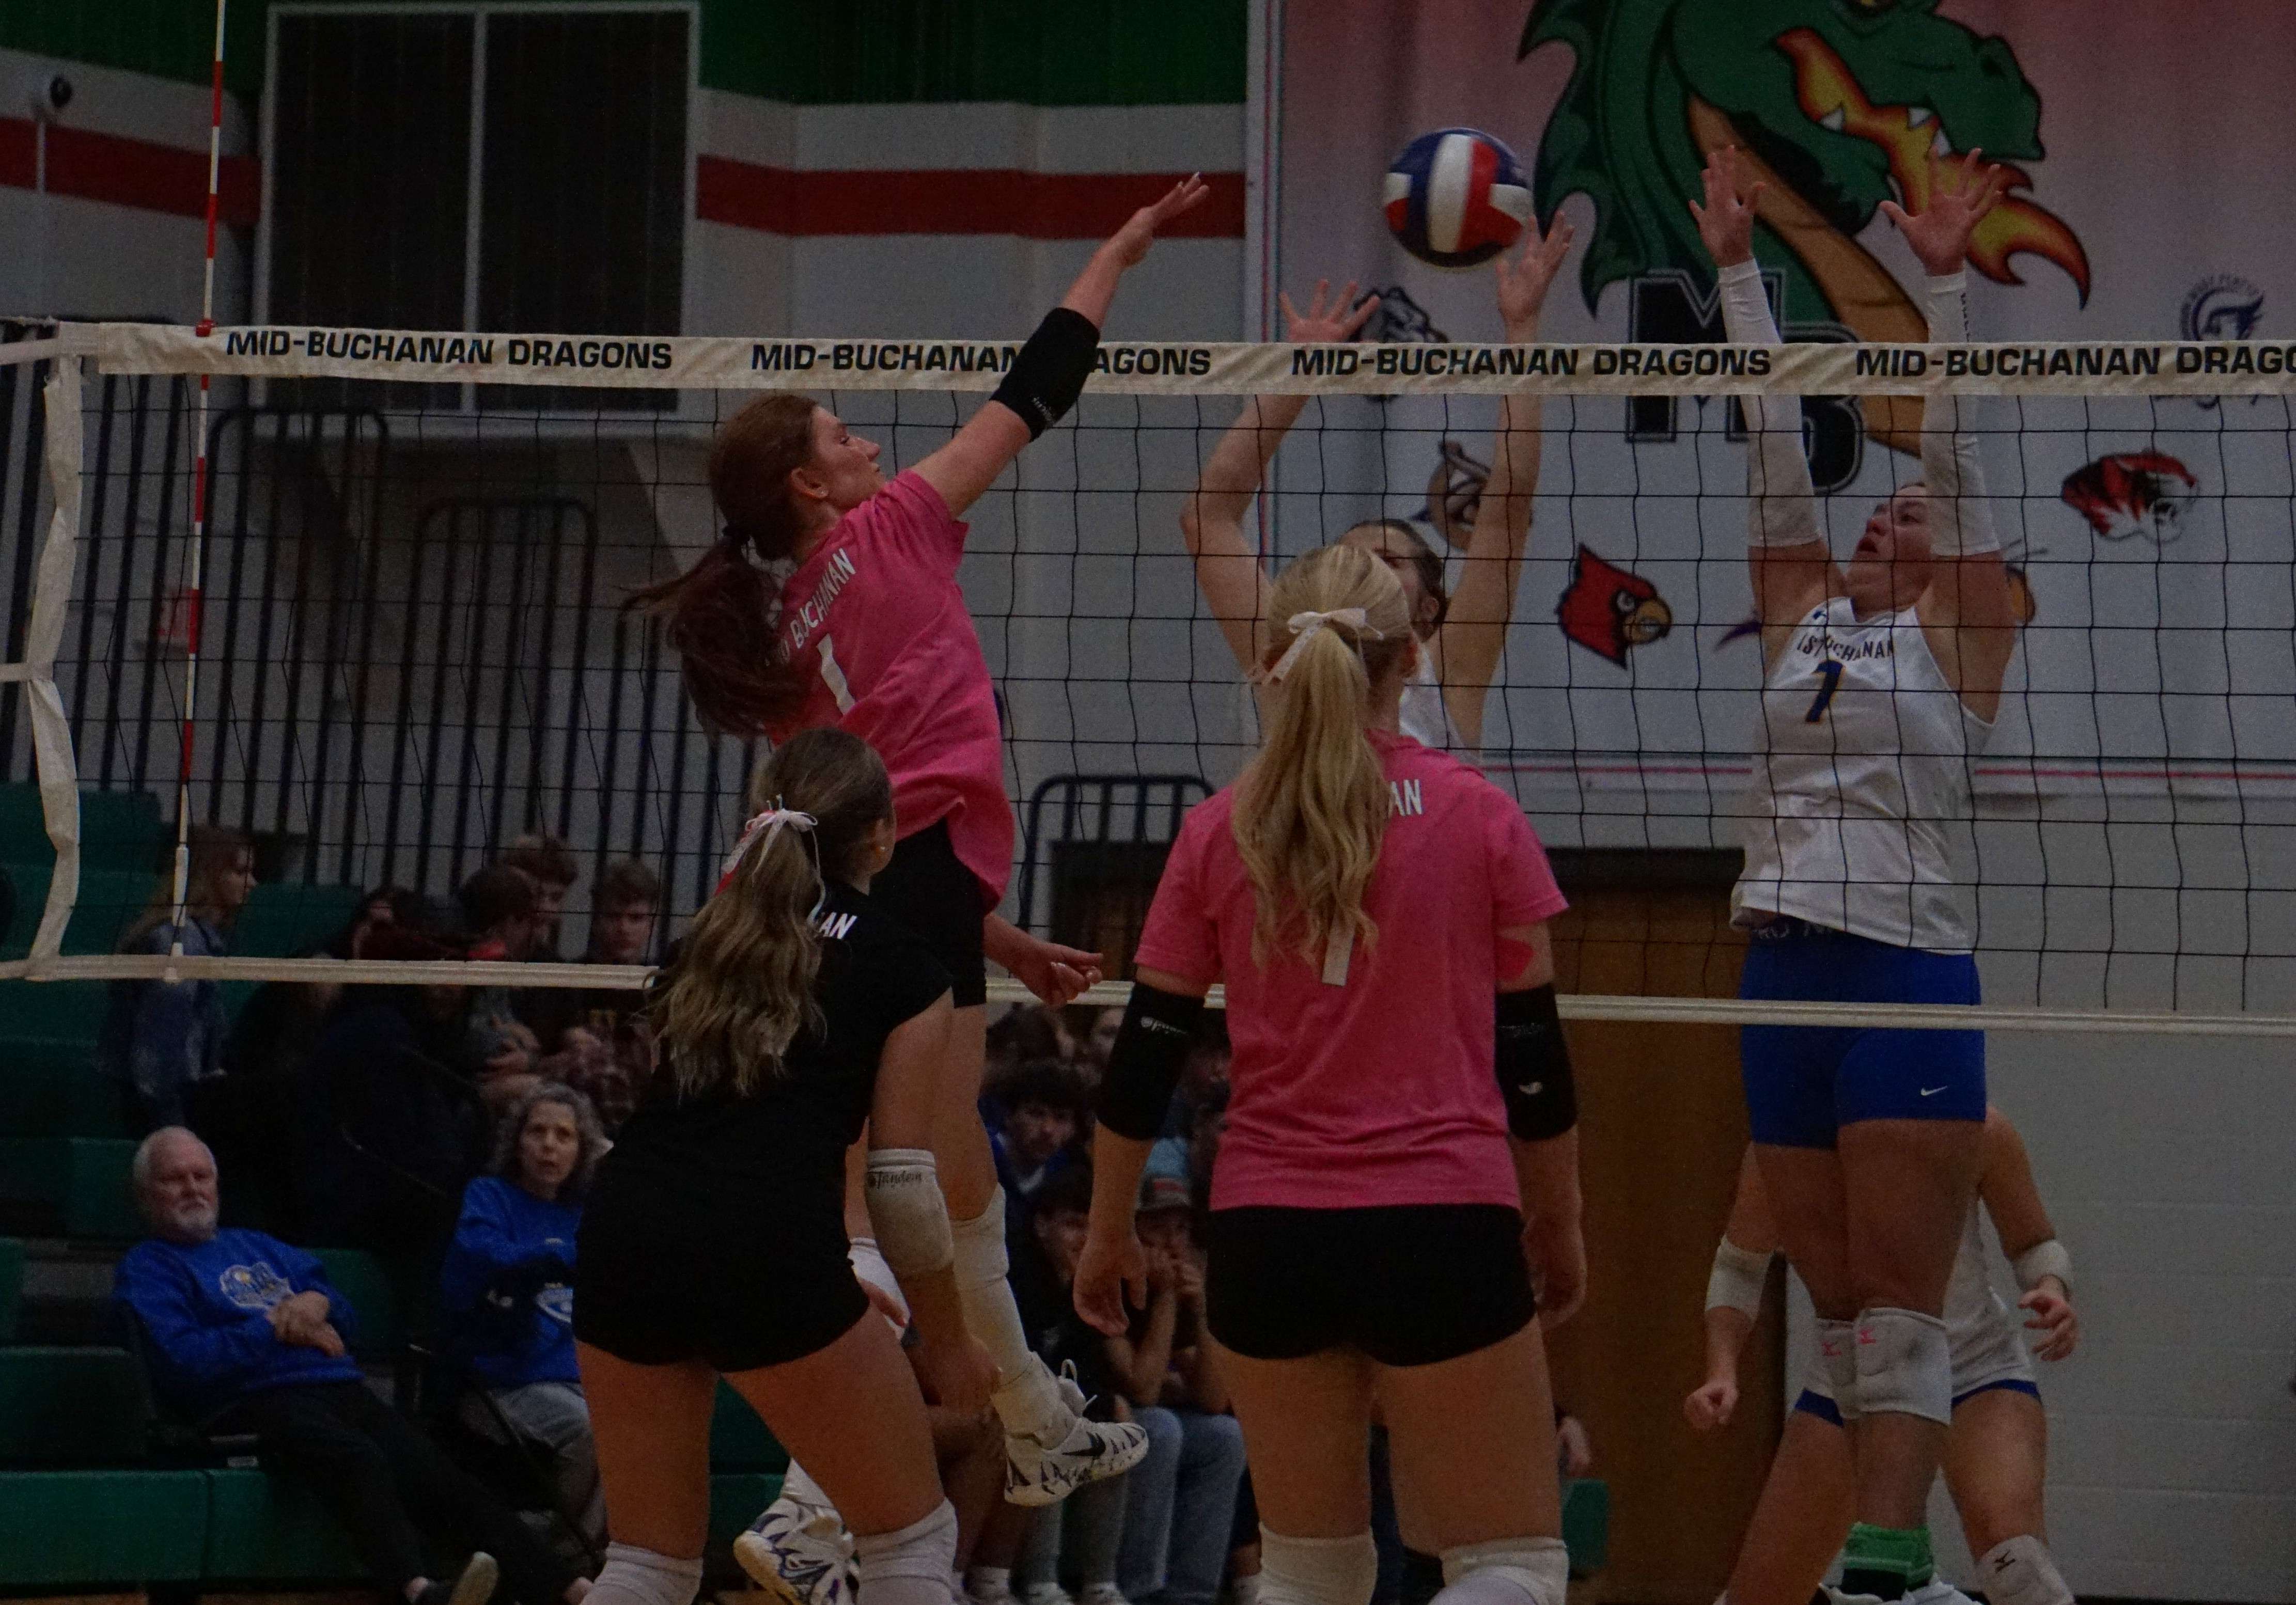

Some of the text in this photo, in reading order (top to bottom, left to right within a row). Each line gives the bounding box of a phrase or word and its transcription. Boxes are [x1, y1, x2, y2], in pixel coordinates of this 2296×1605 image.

[226, 331, 673, 370] MID-BUCHANAN DRAGONS
[1091, 348, 1211, 375] AGONS
[1292, 349, 1771, 375] MID-BUCHANAN DRAGONS
[1857, 348, 2160, 376] MID-BUCHANAN
[1805, 659, 1844, 723] 7
